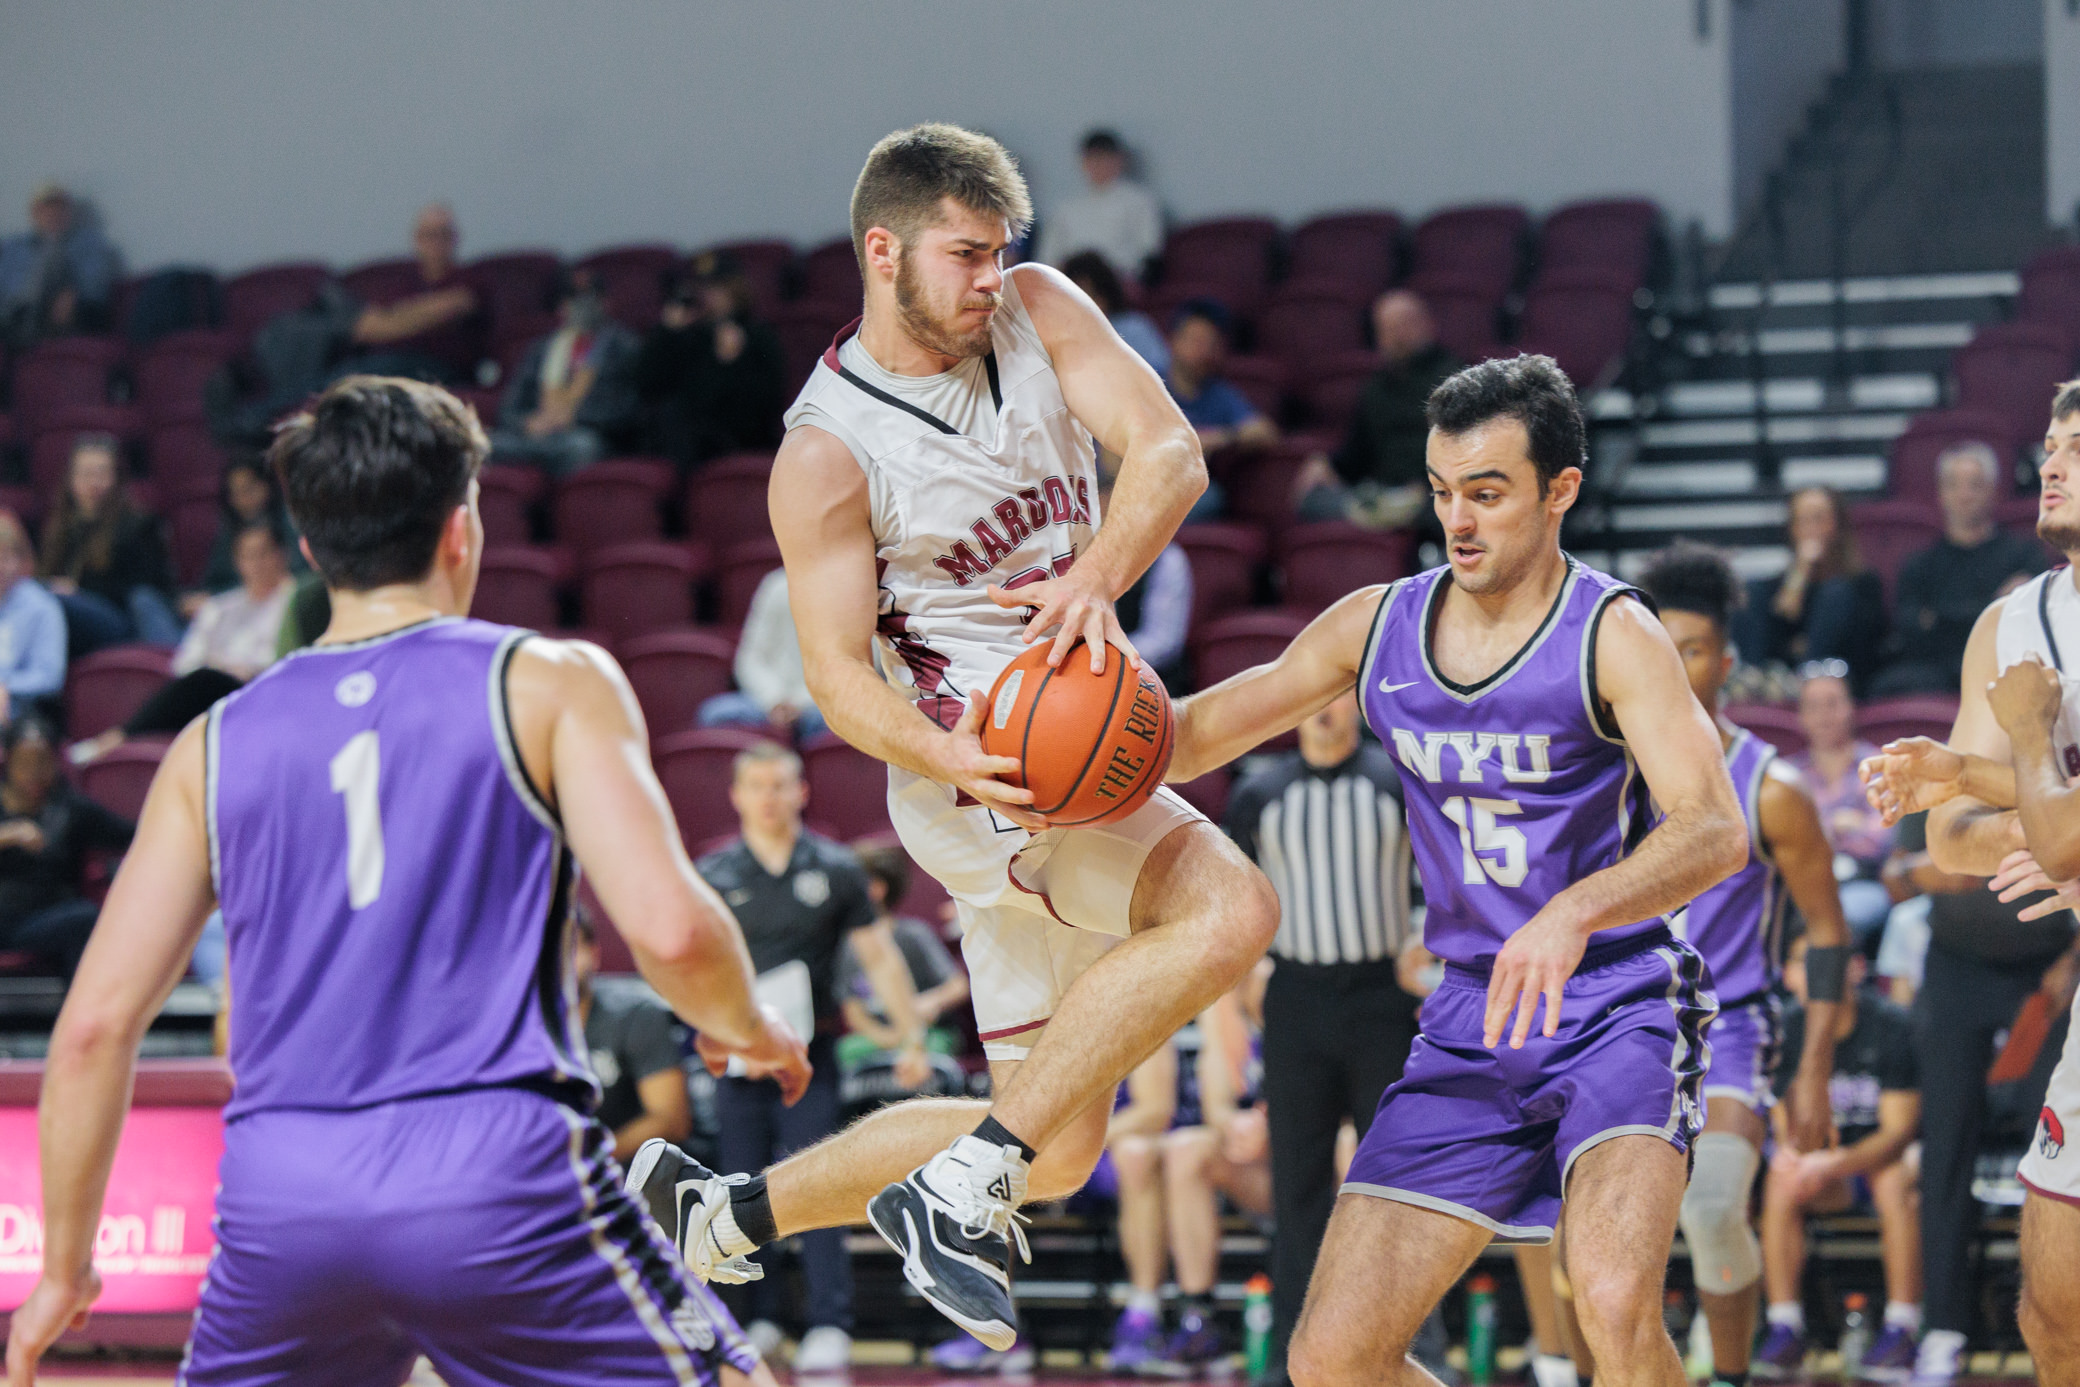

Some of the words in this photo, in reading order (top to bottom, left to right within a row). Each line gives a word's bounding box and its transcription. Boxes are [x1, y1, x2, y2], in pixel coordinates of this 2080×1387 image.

[934, 475, 1092, 587] MAROOS
[1095, 745, 1146, 800] THE
[1123, 675, 1160, 746] ROCK
[1391, 727, 1551, 783] NYU
[329, 729, 386, 911] 1
[1441, 796, 1530, 888] 15
